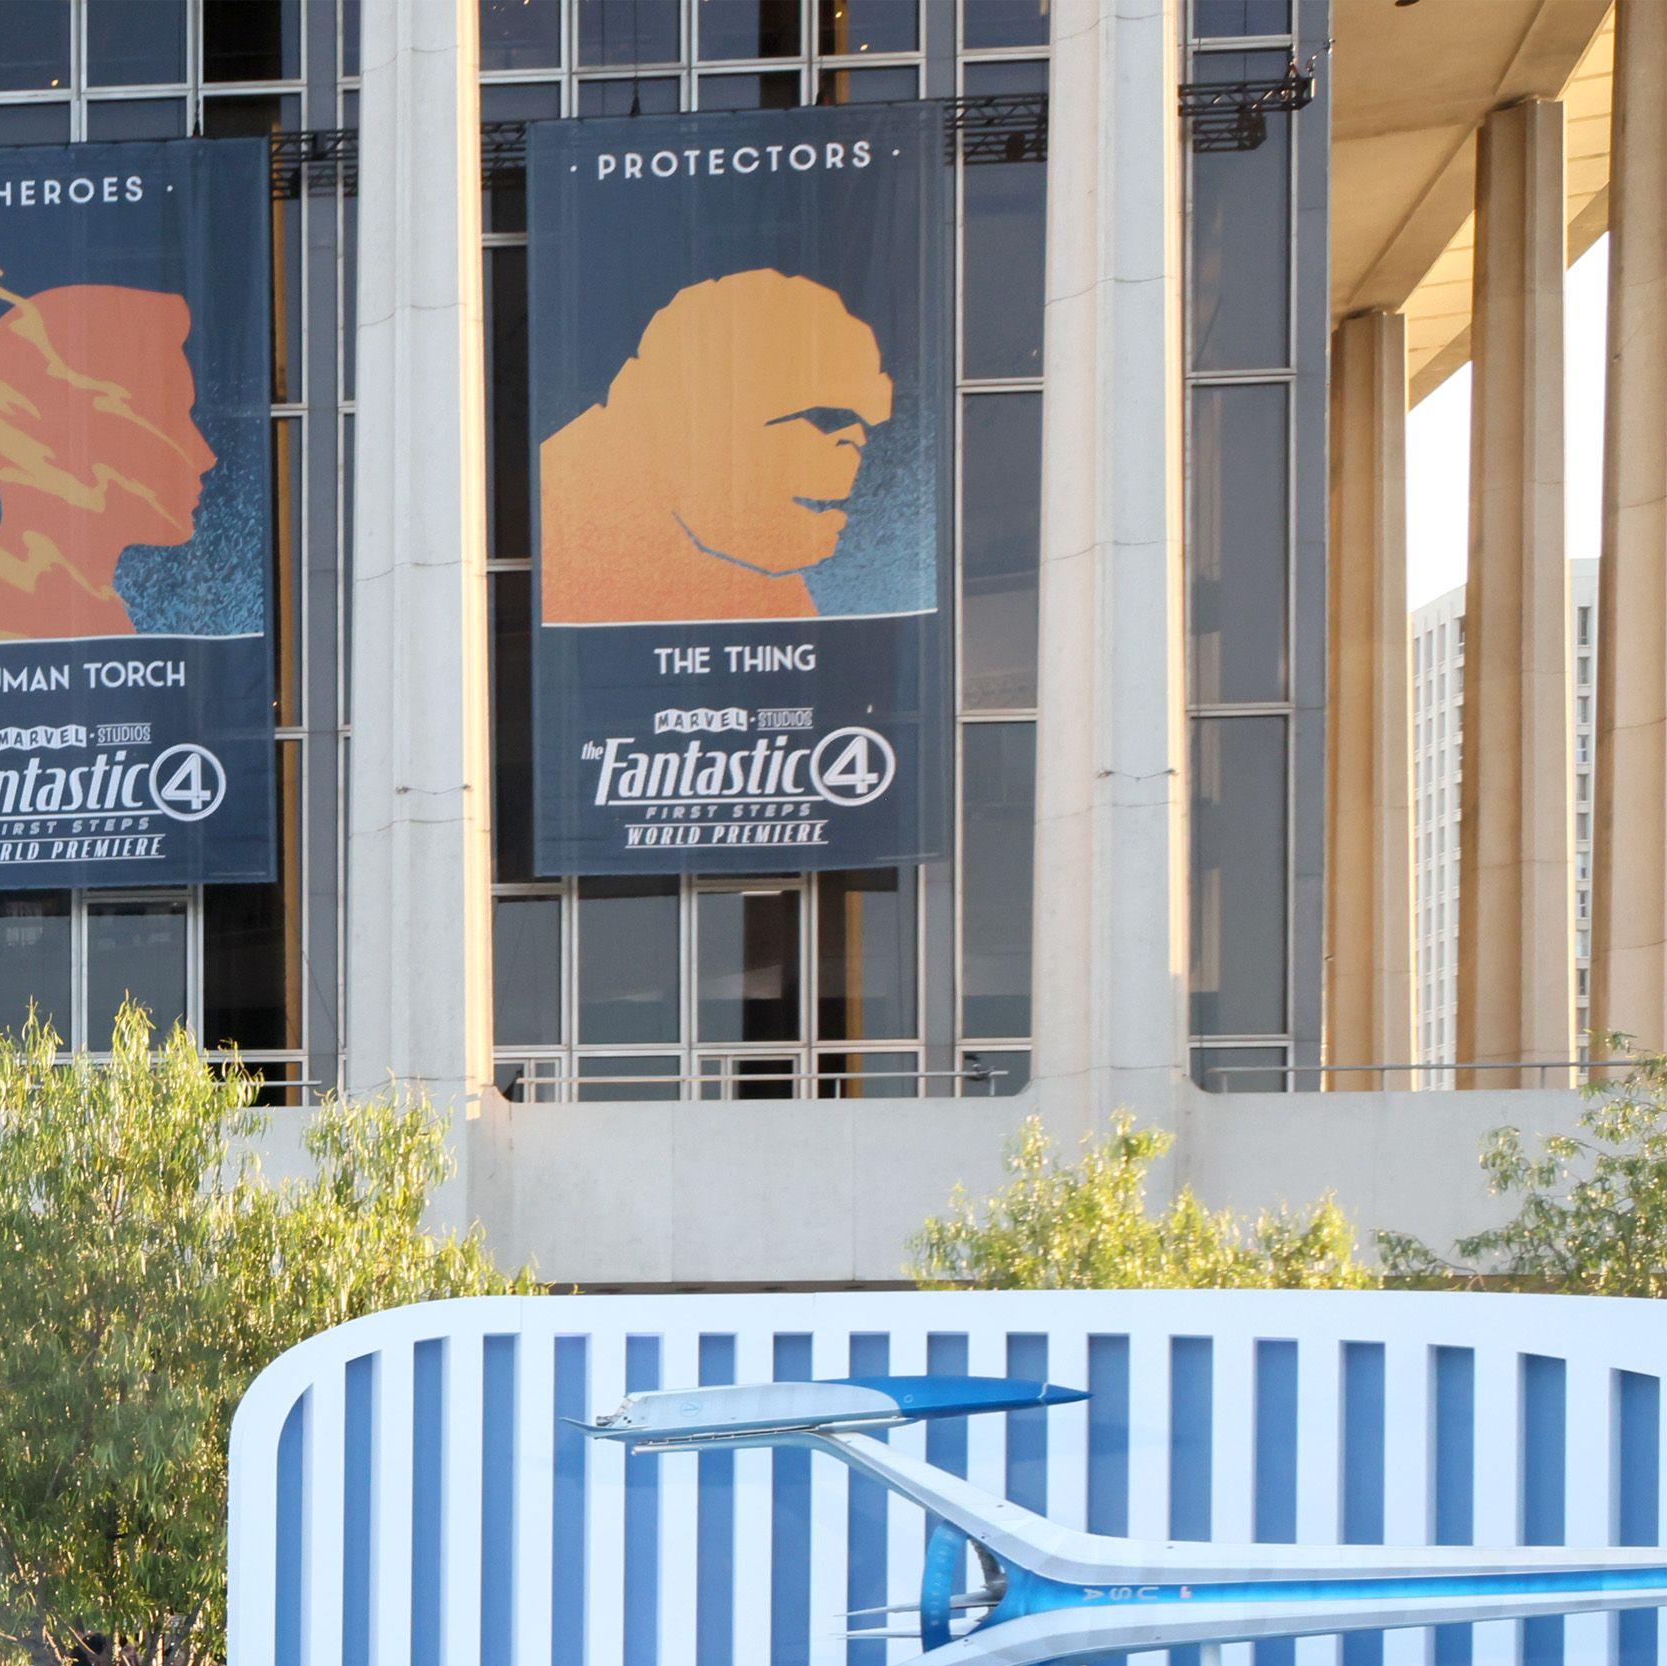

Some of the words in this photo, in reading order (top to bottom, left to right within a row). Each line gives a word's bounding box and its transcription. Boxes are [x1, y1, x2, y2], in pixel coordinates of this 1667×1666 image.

[599, 141, 870, 180] PROTECTORS
[654, 647, 710, 674] THE
[724, 644, 815, 672] THING
[83, 661, 185, 688] TORCH
[654, 708, 747, 734] MARVEL
[98, 726, 151, 743] STUDIOS
[581, 740, 604, 760] the
[595, 736, 811, 806] Fantastic
[645, 806, 716, 819] FIRST
[732, 803, 811, 817] STEPS
[72, 817, 150, 833] STEPS
[627, 826, 699, 846] WORLD
[712, 823, 825, 843] PREMIERE
[51, 837, 162, 859] PREMIERE
